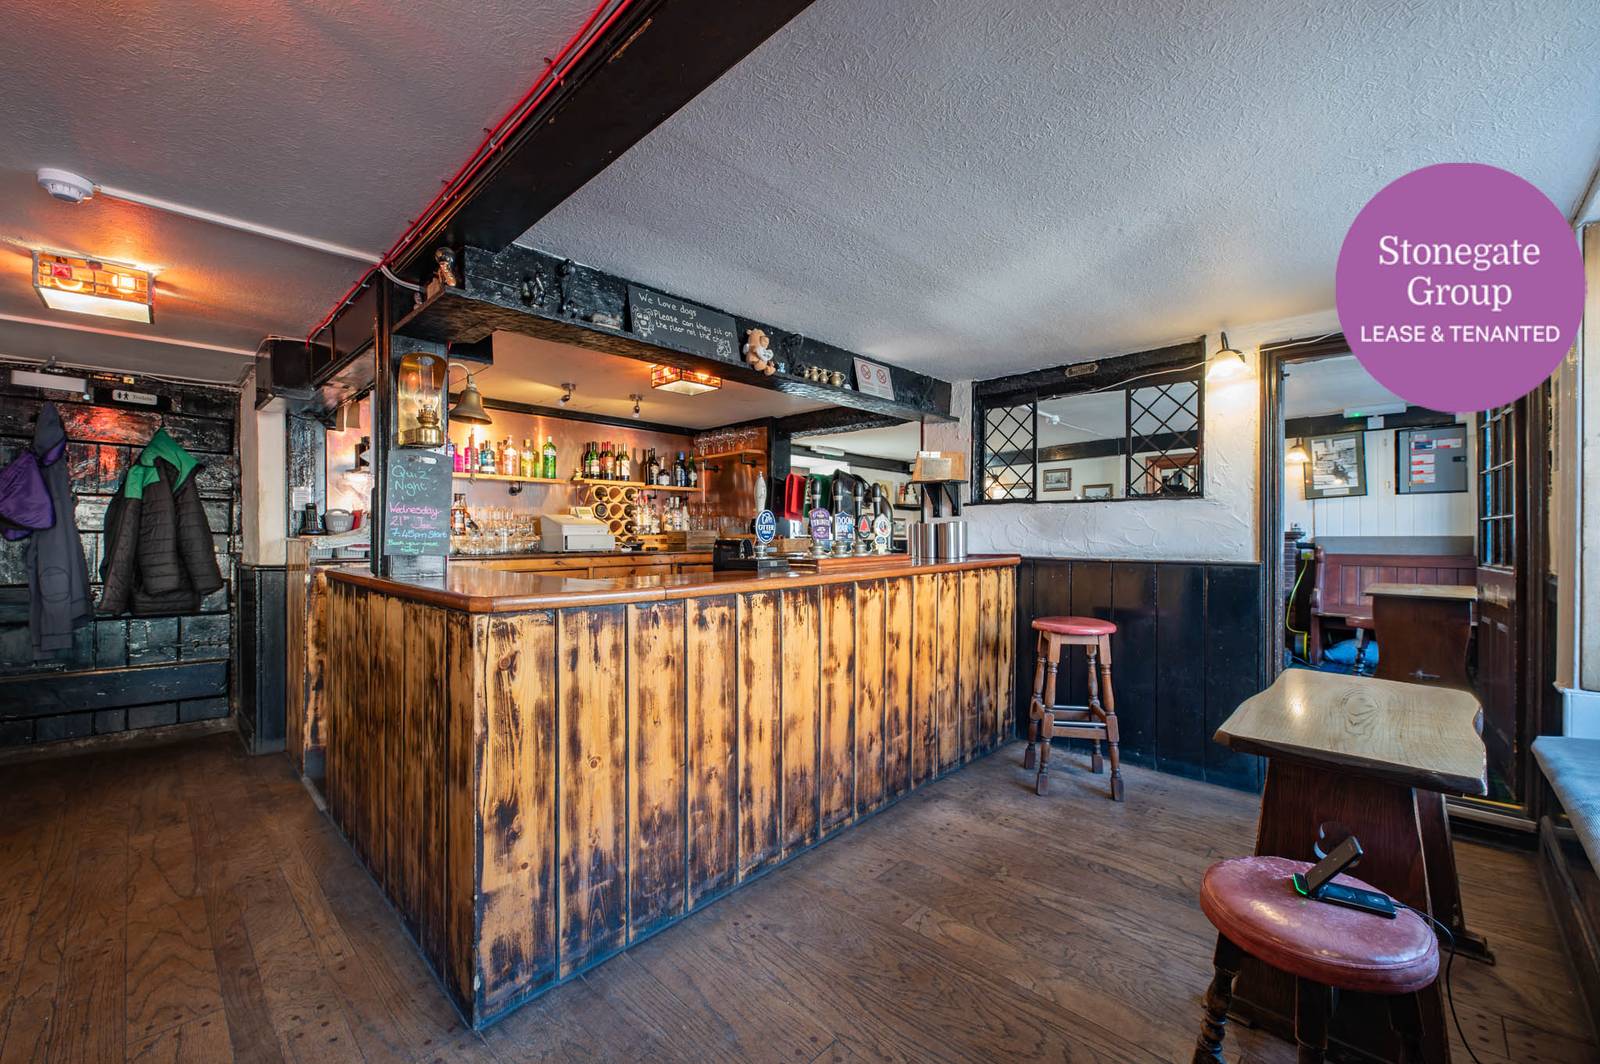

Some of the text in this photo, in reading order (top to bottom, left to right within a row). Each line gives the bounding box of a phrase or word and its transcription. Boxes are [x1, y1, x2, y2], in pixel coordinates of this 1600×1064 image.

[638, 292, 654, 304] We
[679, 304, 697, 319] dogs
[655, 319, 668, 330] the
[682, 320, 694, 328] can
[724, 330, 733, 338] on
[391, 464, 430, 480] Quiz
[394, 481, 427, 497] Night
